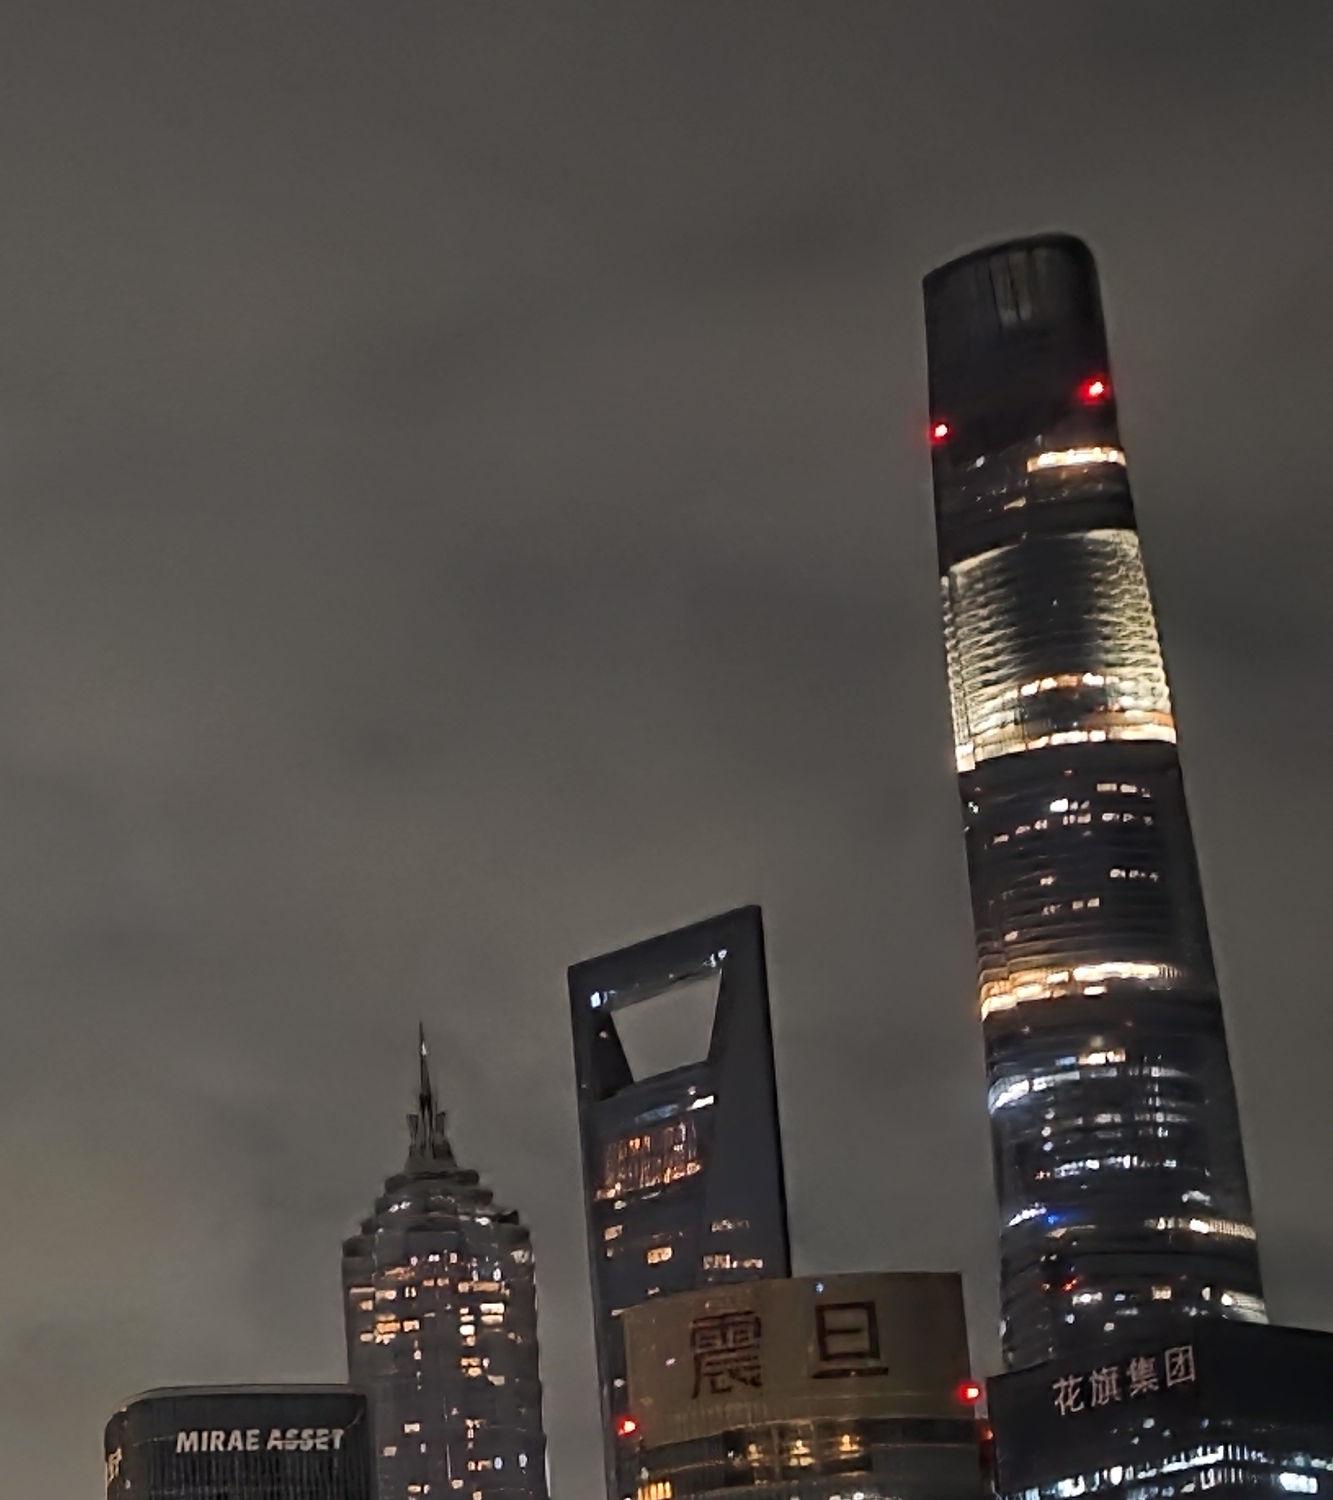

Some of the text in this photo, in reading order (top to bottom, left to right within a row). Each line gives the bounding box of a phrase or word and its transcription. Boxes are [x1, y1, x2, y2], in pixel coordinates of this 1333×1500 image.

[690, 1301, 889, 1399] 震旦
[1053, 1345, 1195, 1416] 花旗集团
[176, 1428, 345, 1453] MIRAE ASSET
